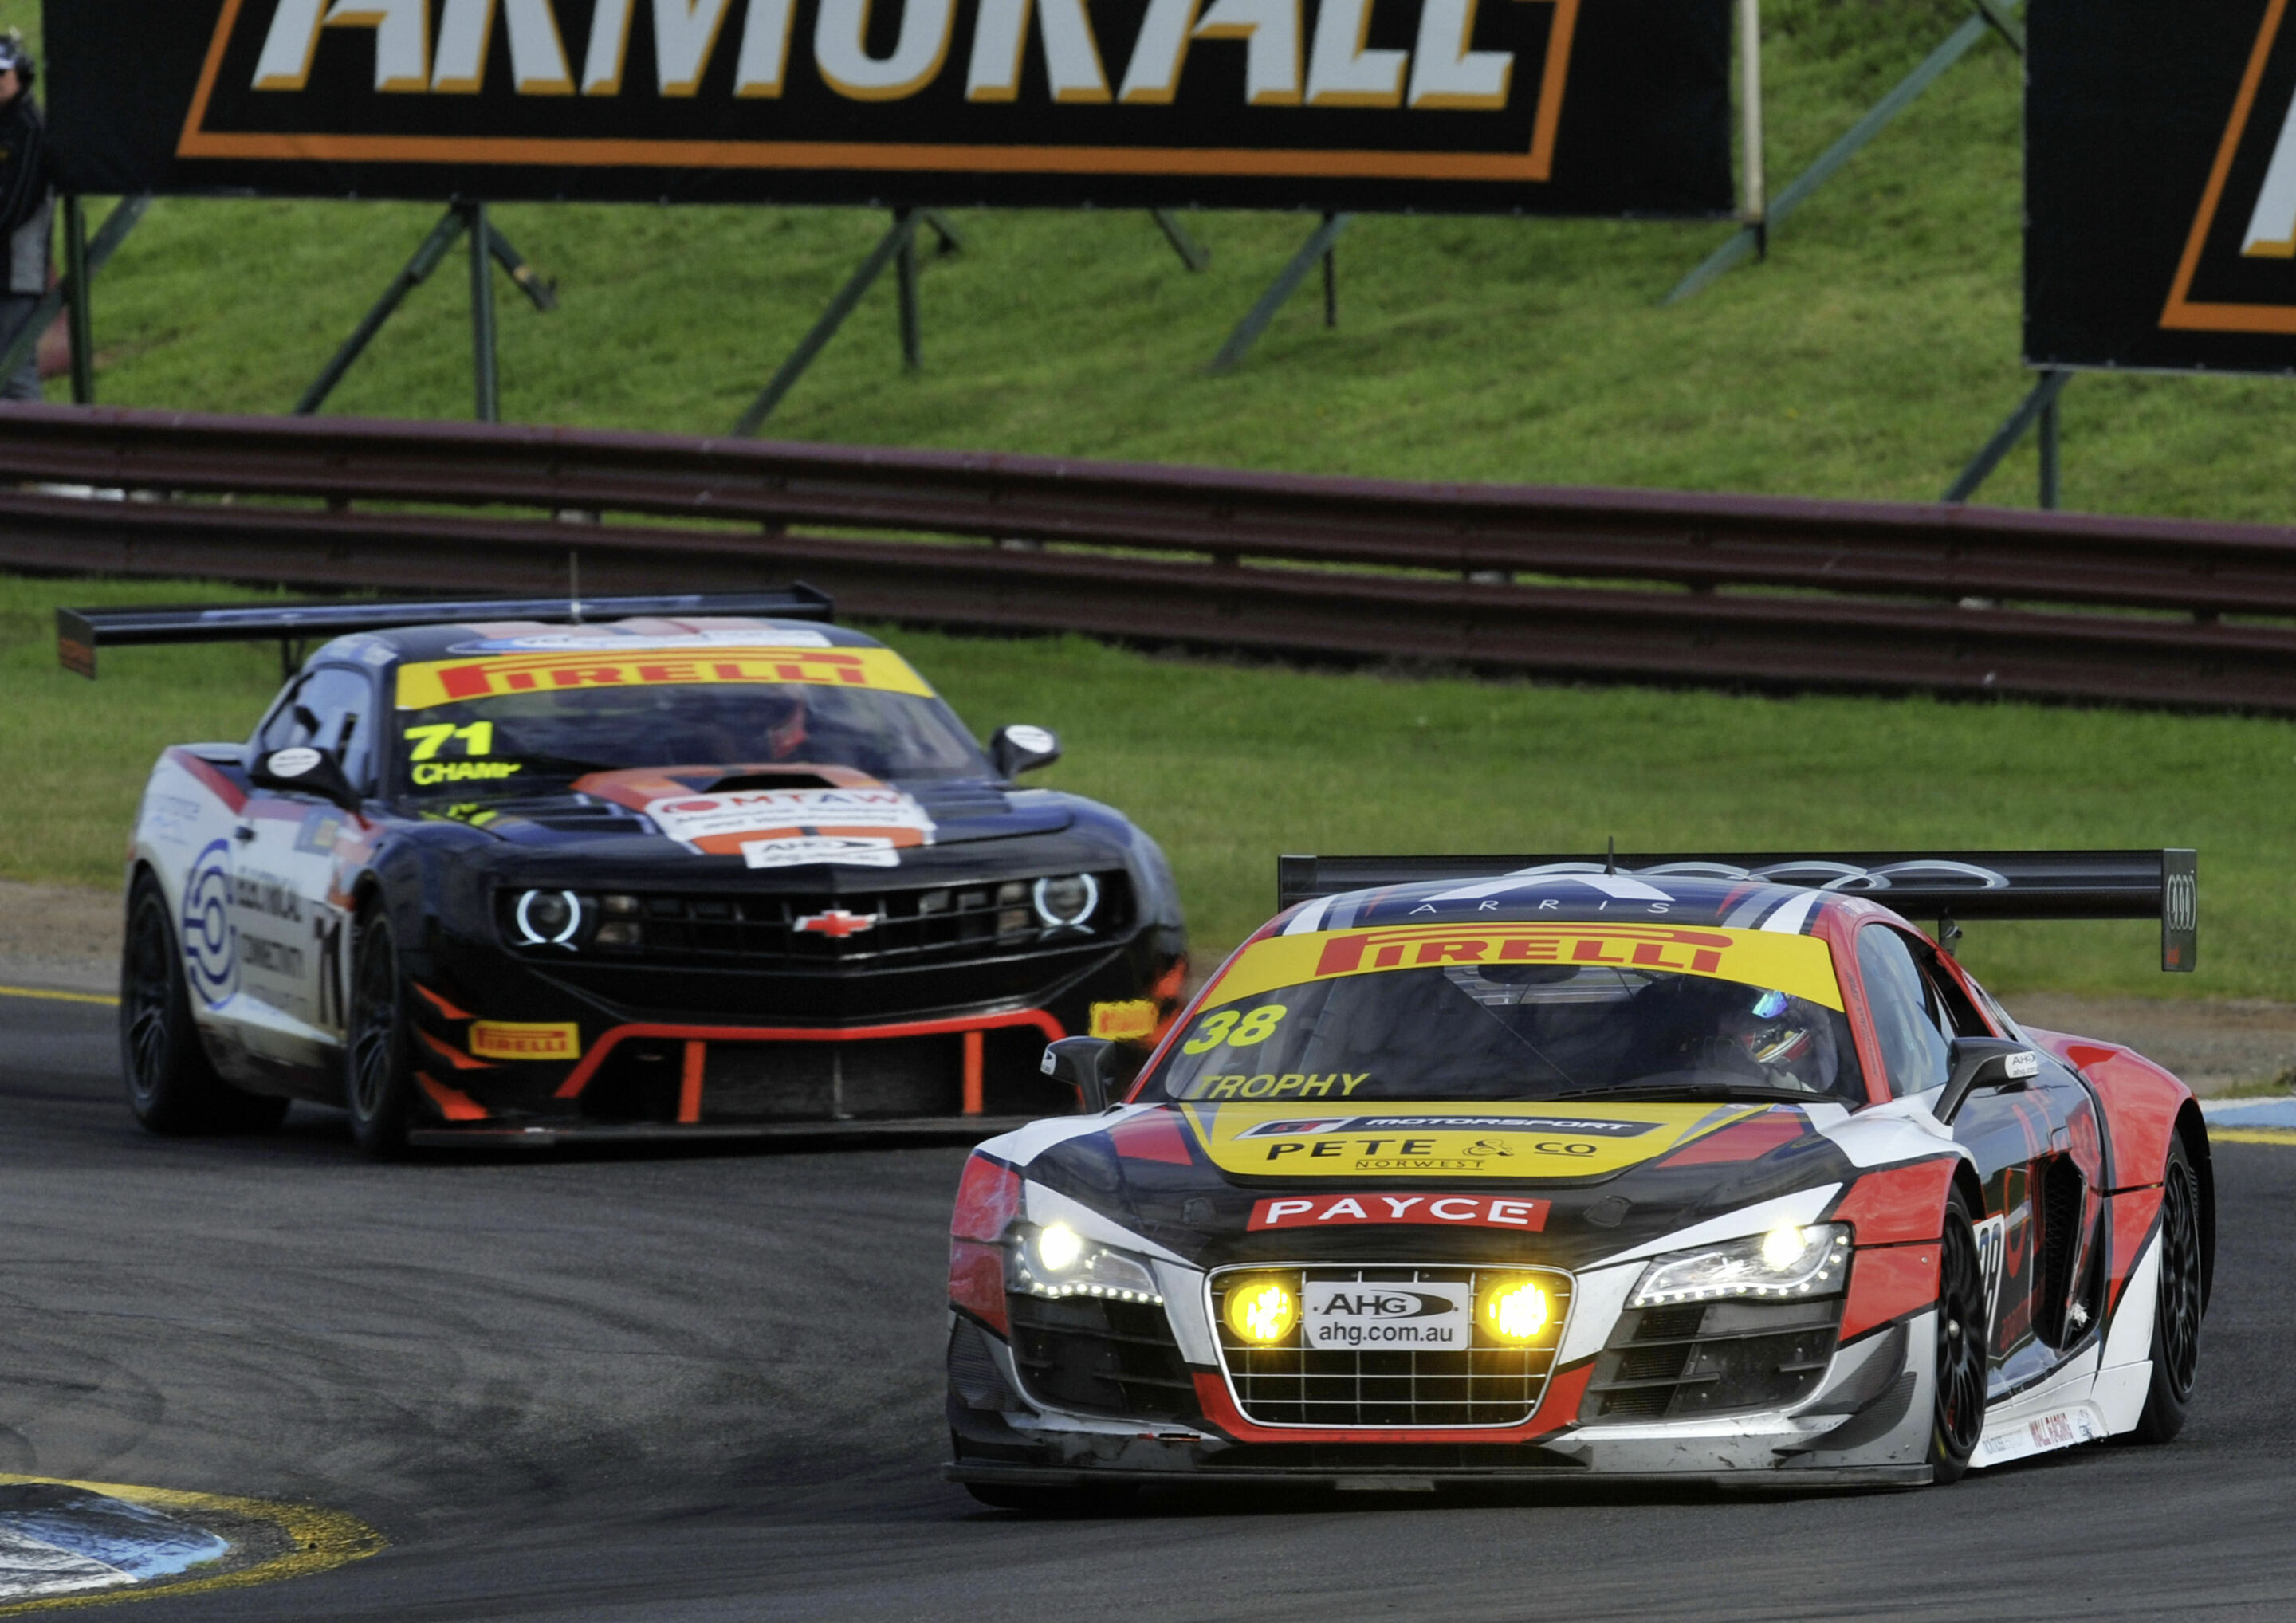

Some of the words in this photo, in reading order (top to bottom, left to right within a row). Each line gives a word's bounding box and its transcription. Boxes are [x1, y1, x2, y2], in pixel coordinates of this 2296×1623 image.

[437, 650, 867, 698] PIRELLI
[403, 721, 493, 761] 71
[411, 762, 523, 785] CHAMP
[1409, 899, 1670, 914] ARRIS
[1315, 923, 1733, 977] PIRELLI
[1183, 1004, 1287, 1055] 38
[1193, 1073, 1370, 1099] TROPHY
[1365, 1117, 1633, 1130] MOTORSPORT
[1267, 1138, 1437, 1161] PETE
[1463, 1138, 1515, 1157] &
[1355, 1160, 1484, 1169] NORWEST
[1264, 1197, 1534, 1224] PAYCE
[1322, 1293, 1406, 1315] AHG
[1319, 1322, 1453, 1346] ahg.com.au
